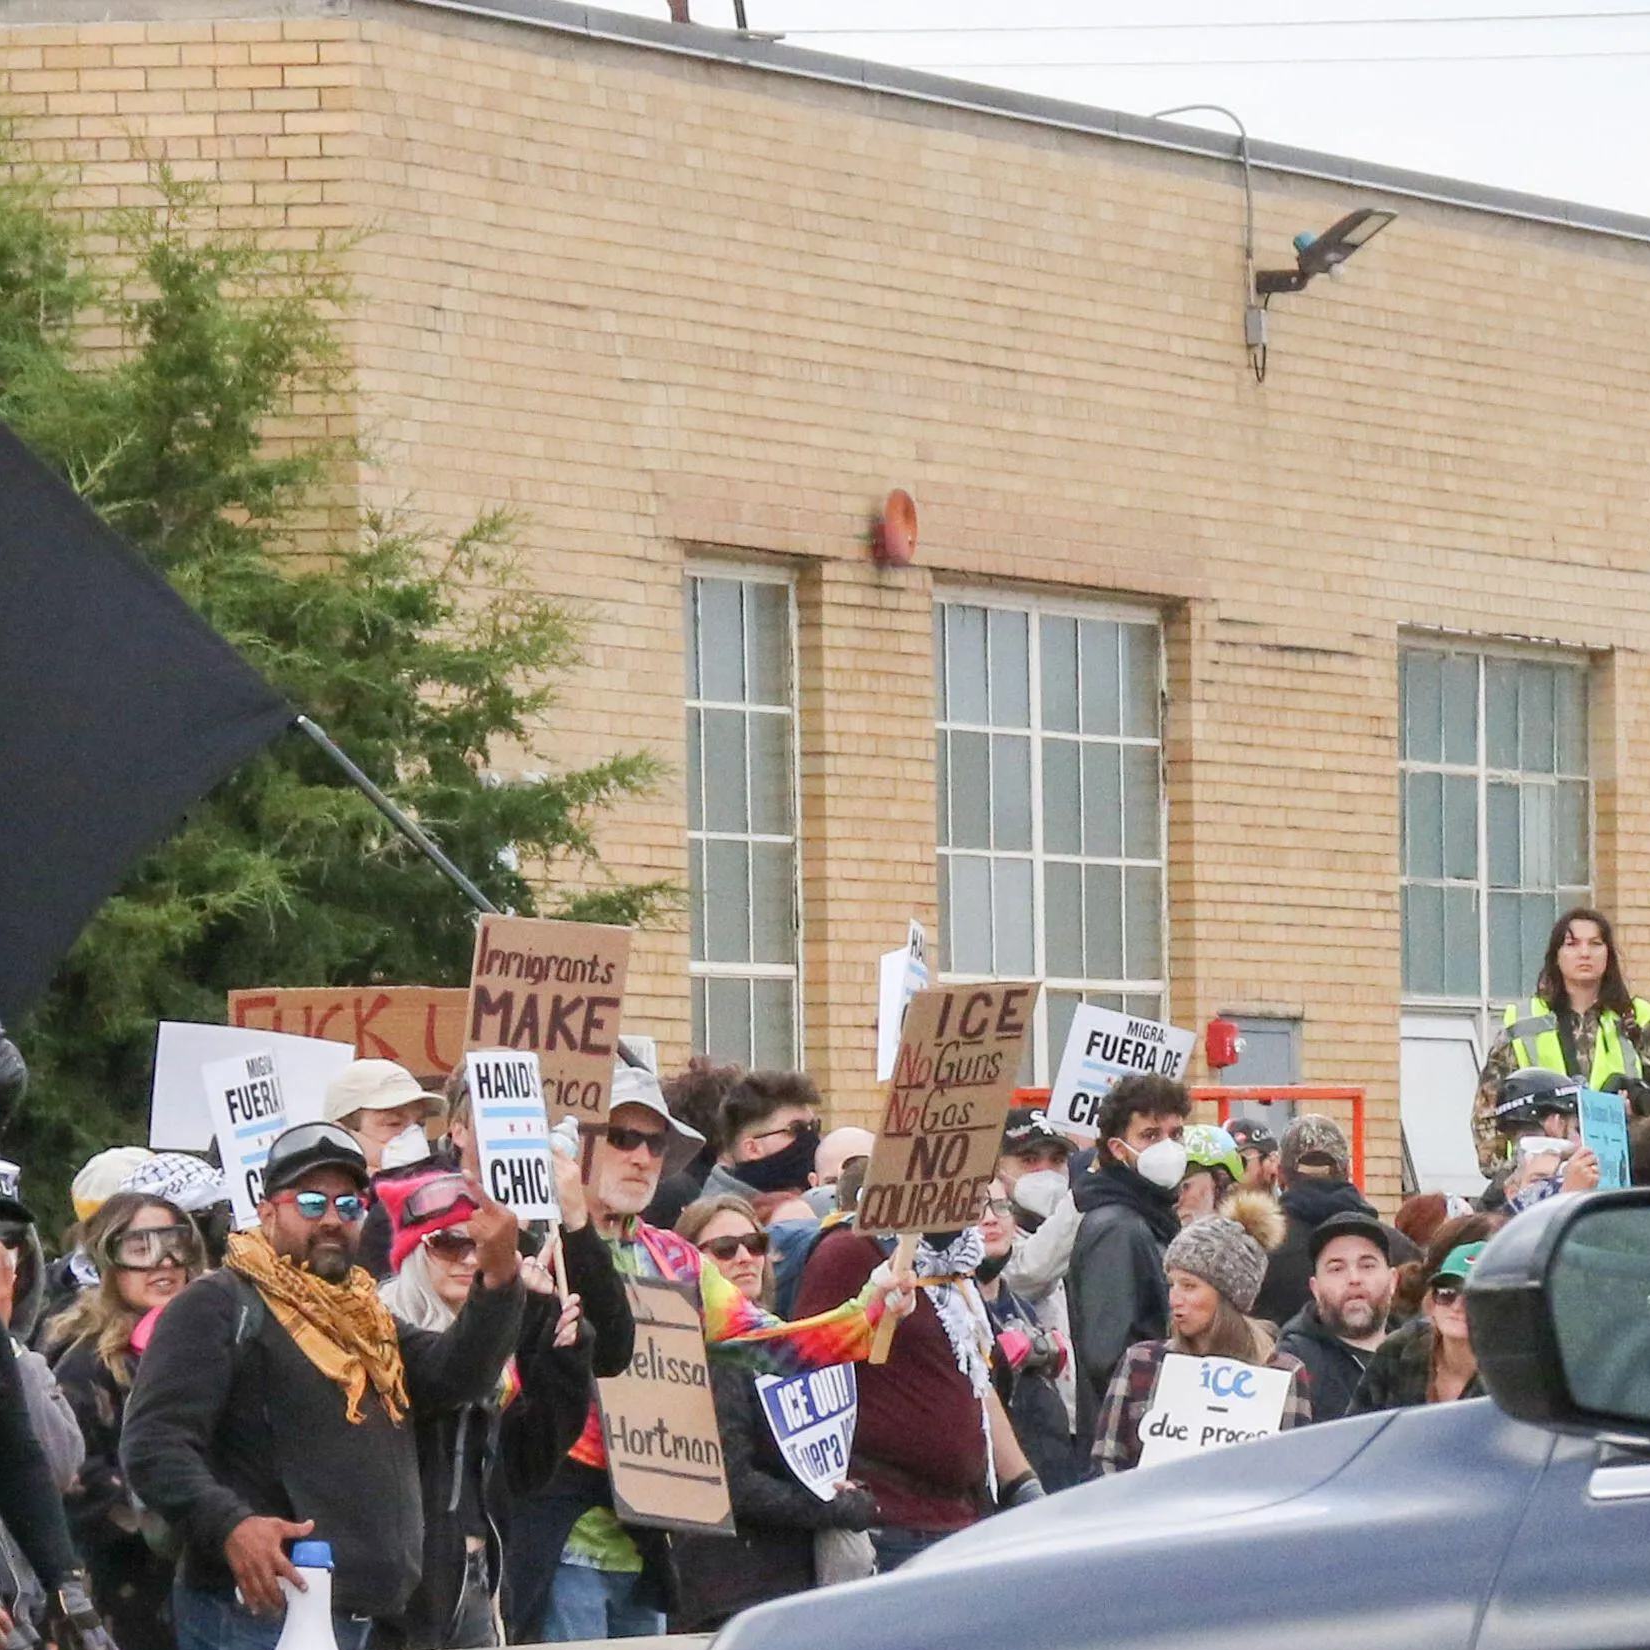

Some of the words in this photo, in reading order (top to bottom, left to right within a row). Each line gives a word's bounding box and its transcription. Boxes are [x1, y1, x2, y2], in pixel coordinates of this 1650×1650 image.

[476, 925, 615, 986] Immigrants
[471, 985, 621, 1055] MAKE
[935, 988, 1030, 1040] ICE
[934, 1040, 1004, 1085] Guns
[1086, 1029, 1158, 1073] FUERA
[1161, 1049, 1183, 1079] DE
[543, 1070, 603, 1112] rica
[920, 1086, 975, 1132] Gas
[905, 1132, 970, 1182] NO
[858, 1174, 993, 1230] COURAGE
[625, 1336, 707, 1388] elissa
[1199, 1361, 1257, 1399] ice
[777, 1378, 815, 1433] ICE
[1149, 1412, 1189, 1441] due
[604, 1411, 721, 1468] Hortman
